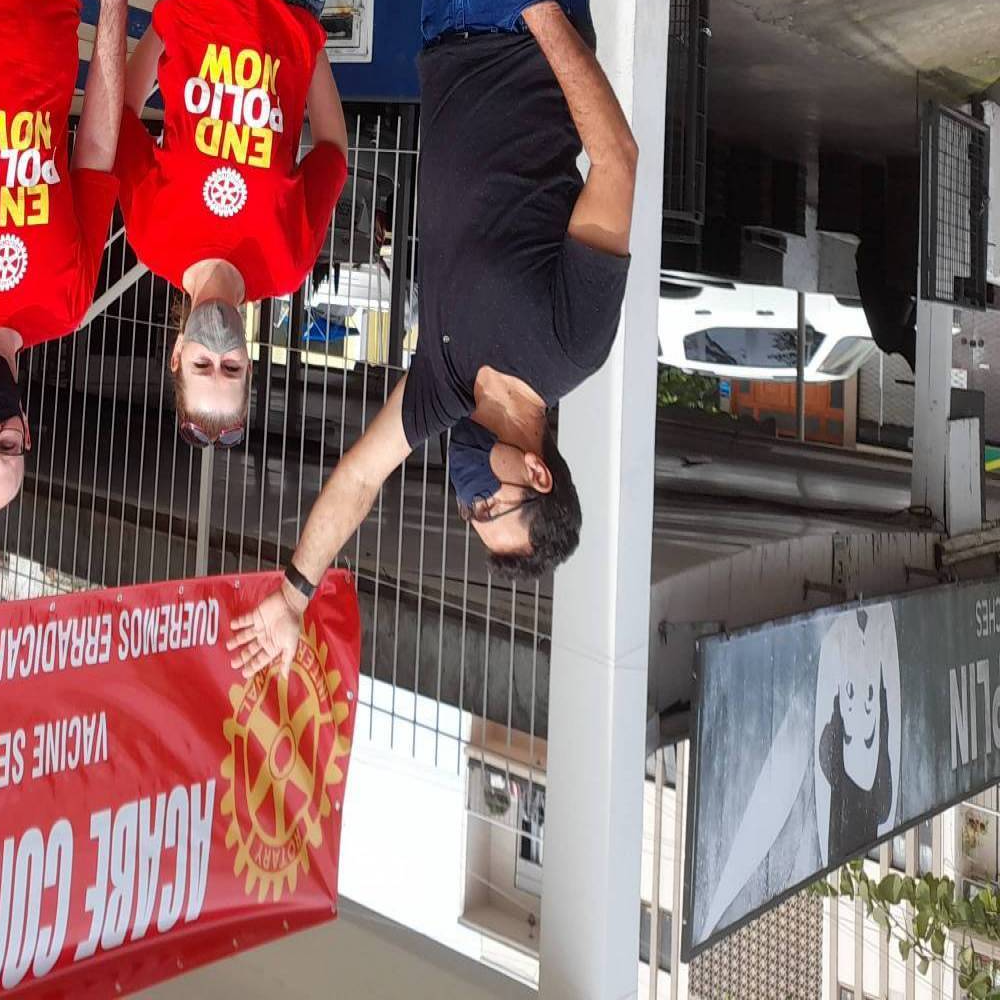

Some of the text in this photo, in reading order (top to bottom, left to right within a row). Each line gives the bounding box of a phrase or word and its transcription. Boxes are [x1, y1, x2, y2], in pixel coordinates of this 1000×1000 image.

[198, 43, 281, 96] NOW
[184, 77, 283, 133] POLIO
[194, 116, 273, 169] END
[118, 597, 220, 662] QUEREMOS
[32, 711, 108, 780] VACINE
[74, 778, 215, 961] ACABE
